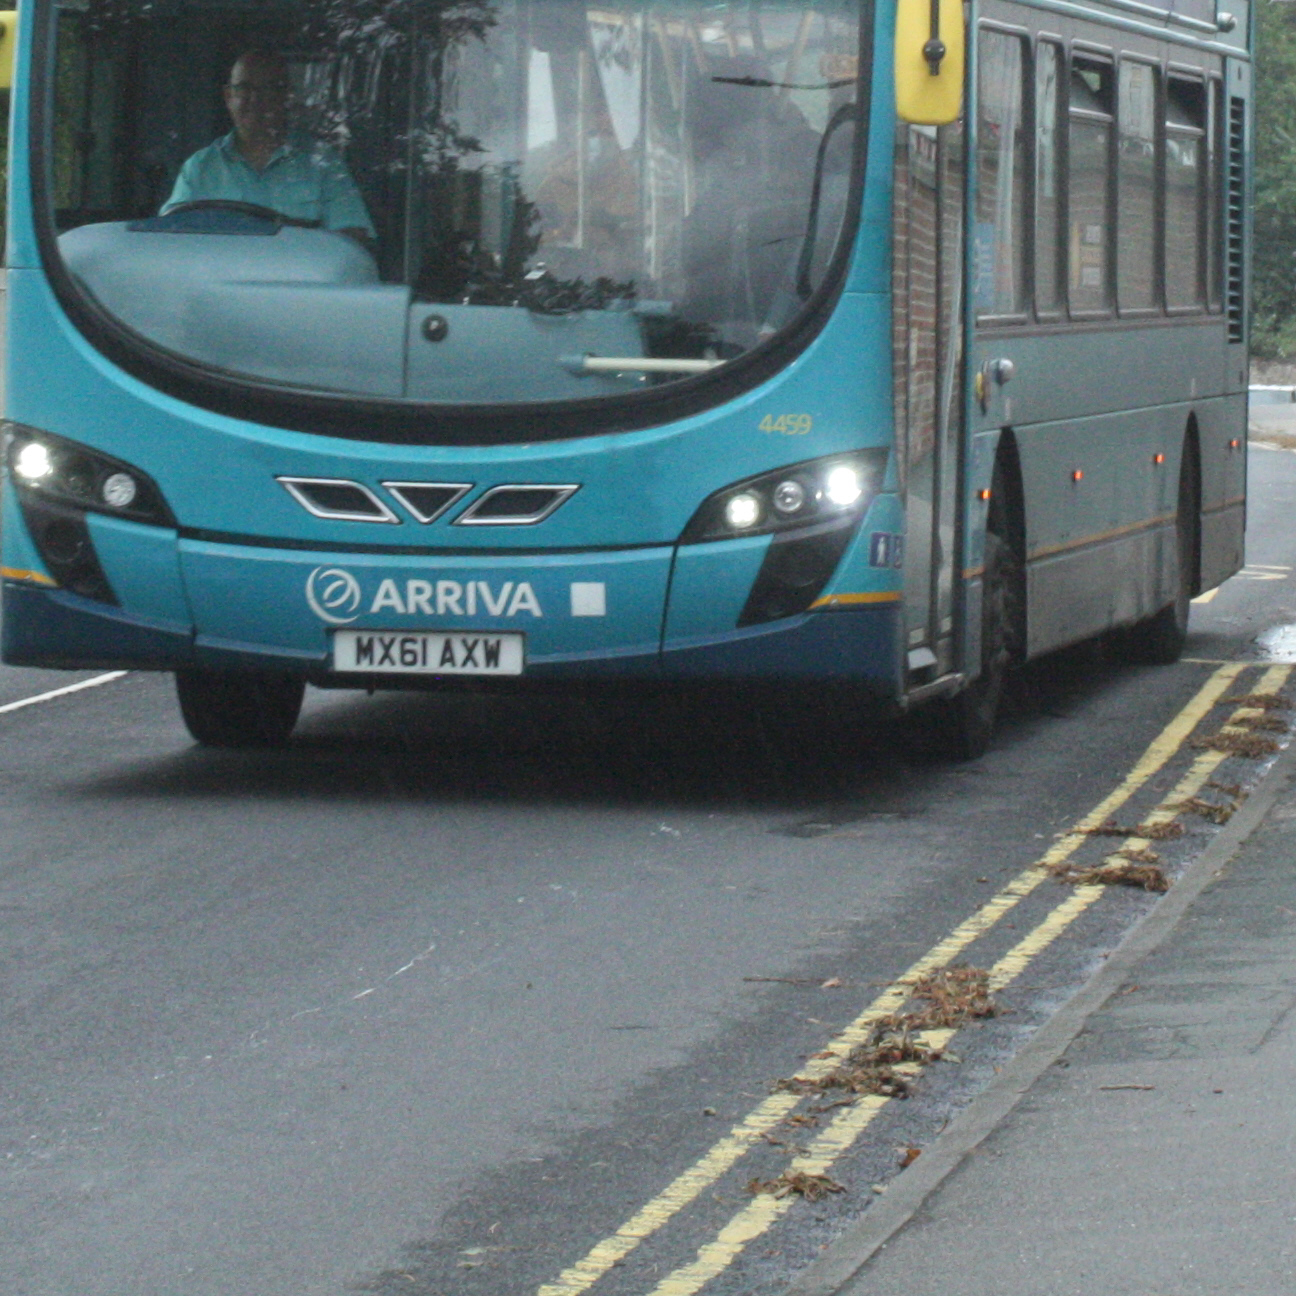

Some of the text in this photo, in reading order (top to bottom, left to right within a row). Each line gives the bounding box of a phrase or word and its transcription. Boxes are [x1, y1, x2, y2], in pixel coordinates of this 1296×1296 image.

[758, 413, 812, 435] 4459
[369, 578, 543, 618] ARRIVA
[355, 636, 502, 669] MX61 AXW
